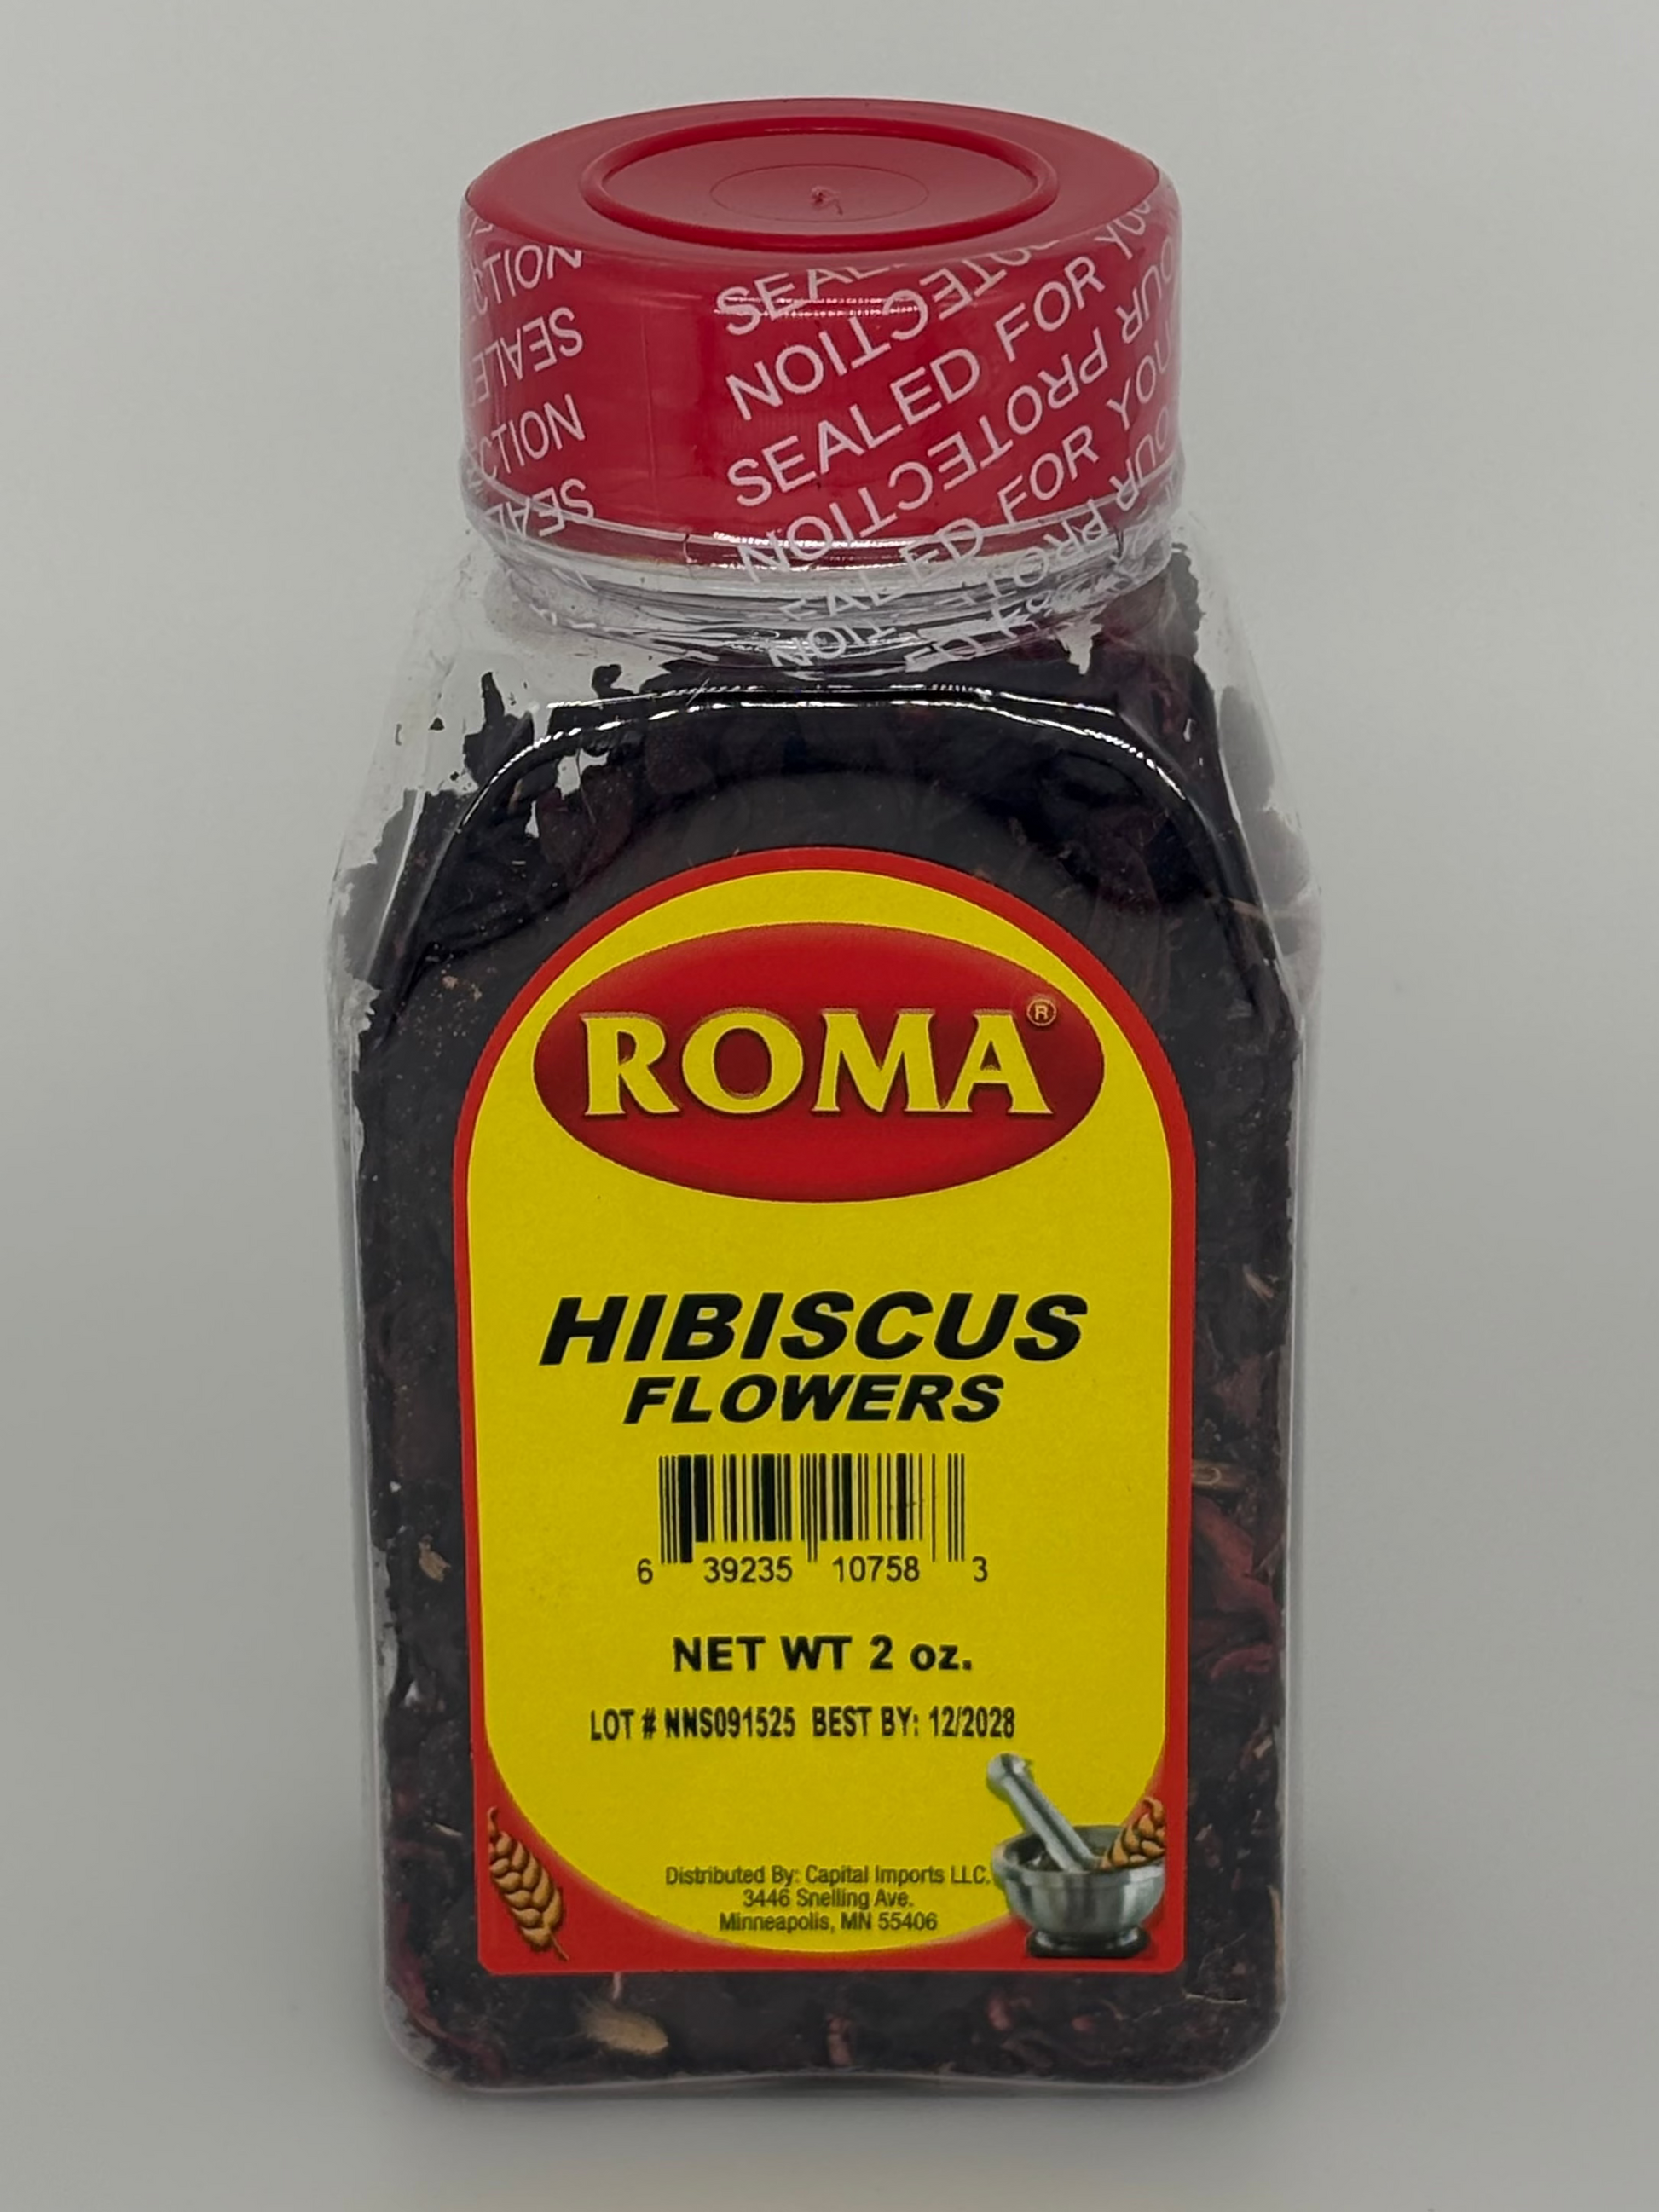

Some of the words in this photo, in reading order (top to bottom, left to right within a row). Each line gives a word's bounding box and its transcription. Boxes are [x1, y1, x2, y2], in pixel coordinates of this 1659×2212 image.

[1114, 235, 1175, 344] OUR
[727, 348, 980, 507] SEALED
[994, 255, 1106, 362] FOR
[738, 327, 1109, 583] PROTECTION
[1108, 406, 1169, 511] OUR
[779, 517, 985, 621] EALED
[996, 425, 1100, 526] FOR
[580, 1008, 1053, 1116] ROMA
[539, 1291, 1089, 1366] HIBISCUS
[622, 1373, 1005, 1425] FLOWERS
[637, 1557, 654, 1585] 6
[703, 1556, 793, 1584] 39235
[832, 1555, 921, 1583] 10758
[972, 1556, 988, 1583] 3
[672, 1635, 766, 1672] NET
[779, 1634, 853, 1672] WT
[869, 1634, 894, 1672] 2
[910, 1643, 973, 1672] oz.
[590, 1708, 635, 1741] LOT
[641, 1707, 657, 1740] #
[664, 1705, 796, 1740] NNS091525
[812, 1705, 873, 1738] BEST
[880, 1706, 920, 1738] BY:
[928, 1705, 1015, 1740] 12/2028
[665, 1865, 766, 1886] Distributed
[771, 1865, 800, 1888] By:
[805, 1864, 869, 1888] Capital
[875, 1865, 945, 1888] Imports
[743, 1888, 791, 1909] 3446
[796, 1887, 870, 1910] Snelling
[873, 1888, 914, 1908] Ave.
[719, 1911, 836, 1934] Minneapolis,
[840, 1911, 872, 1932] MN
[877, 1911, 939, 1932] 55406
